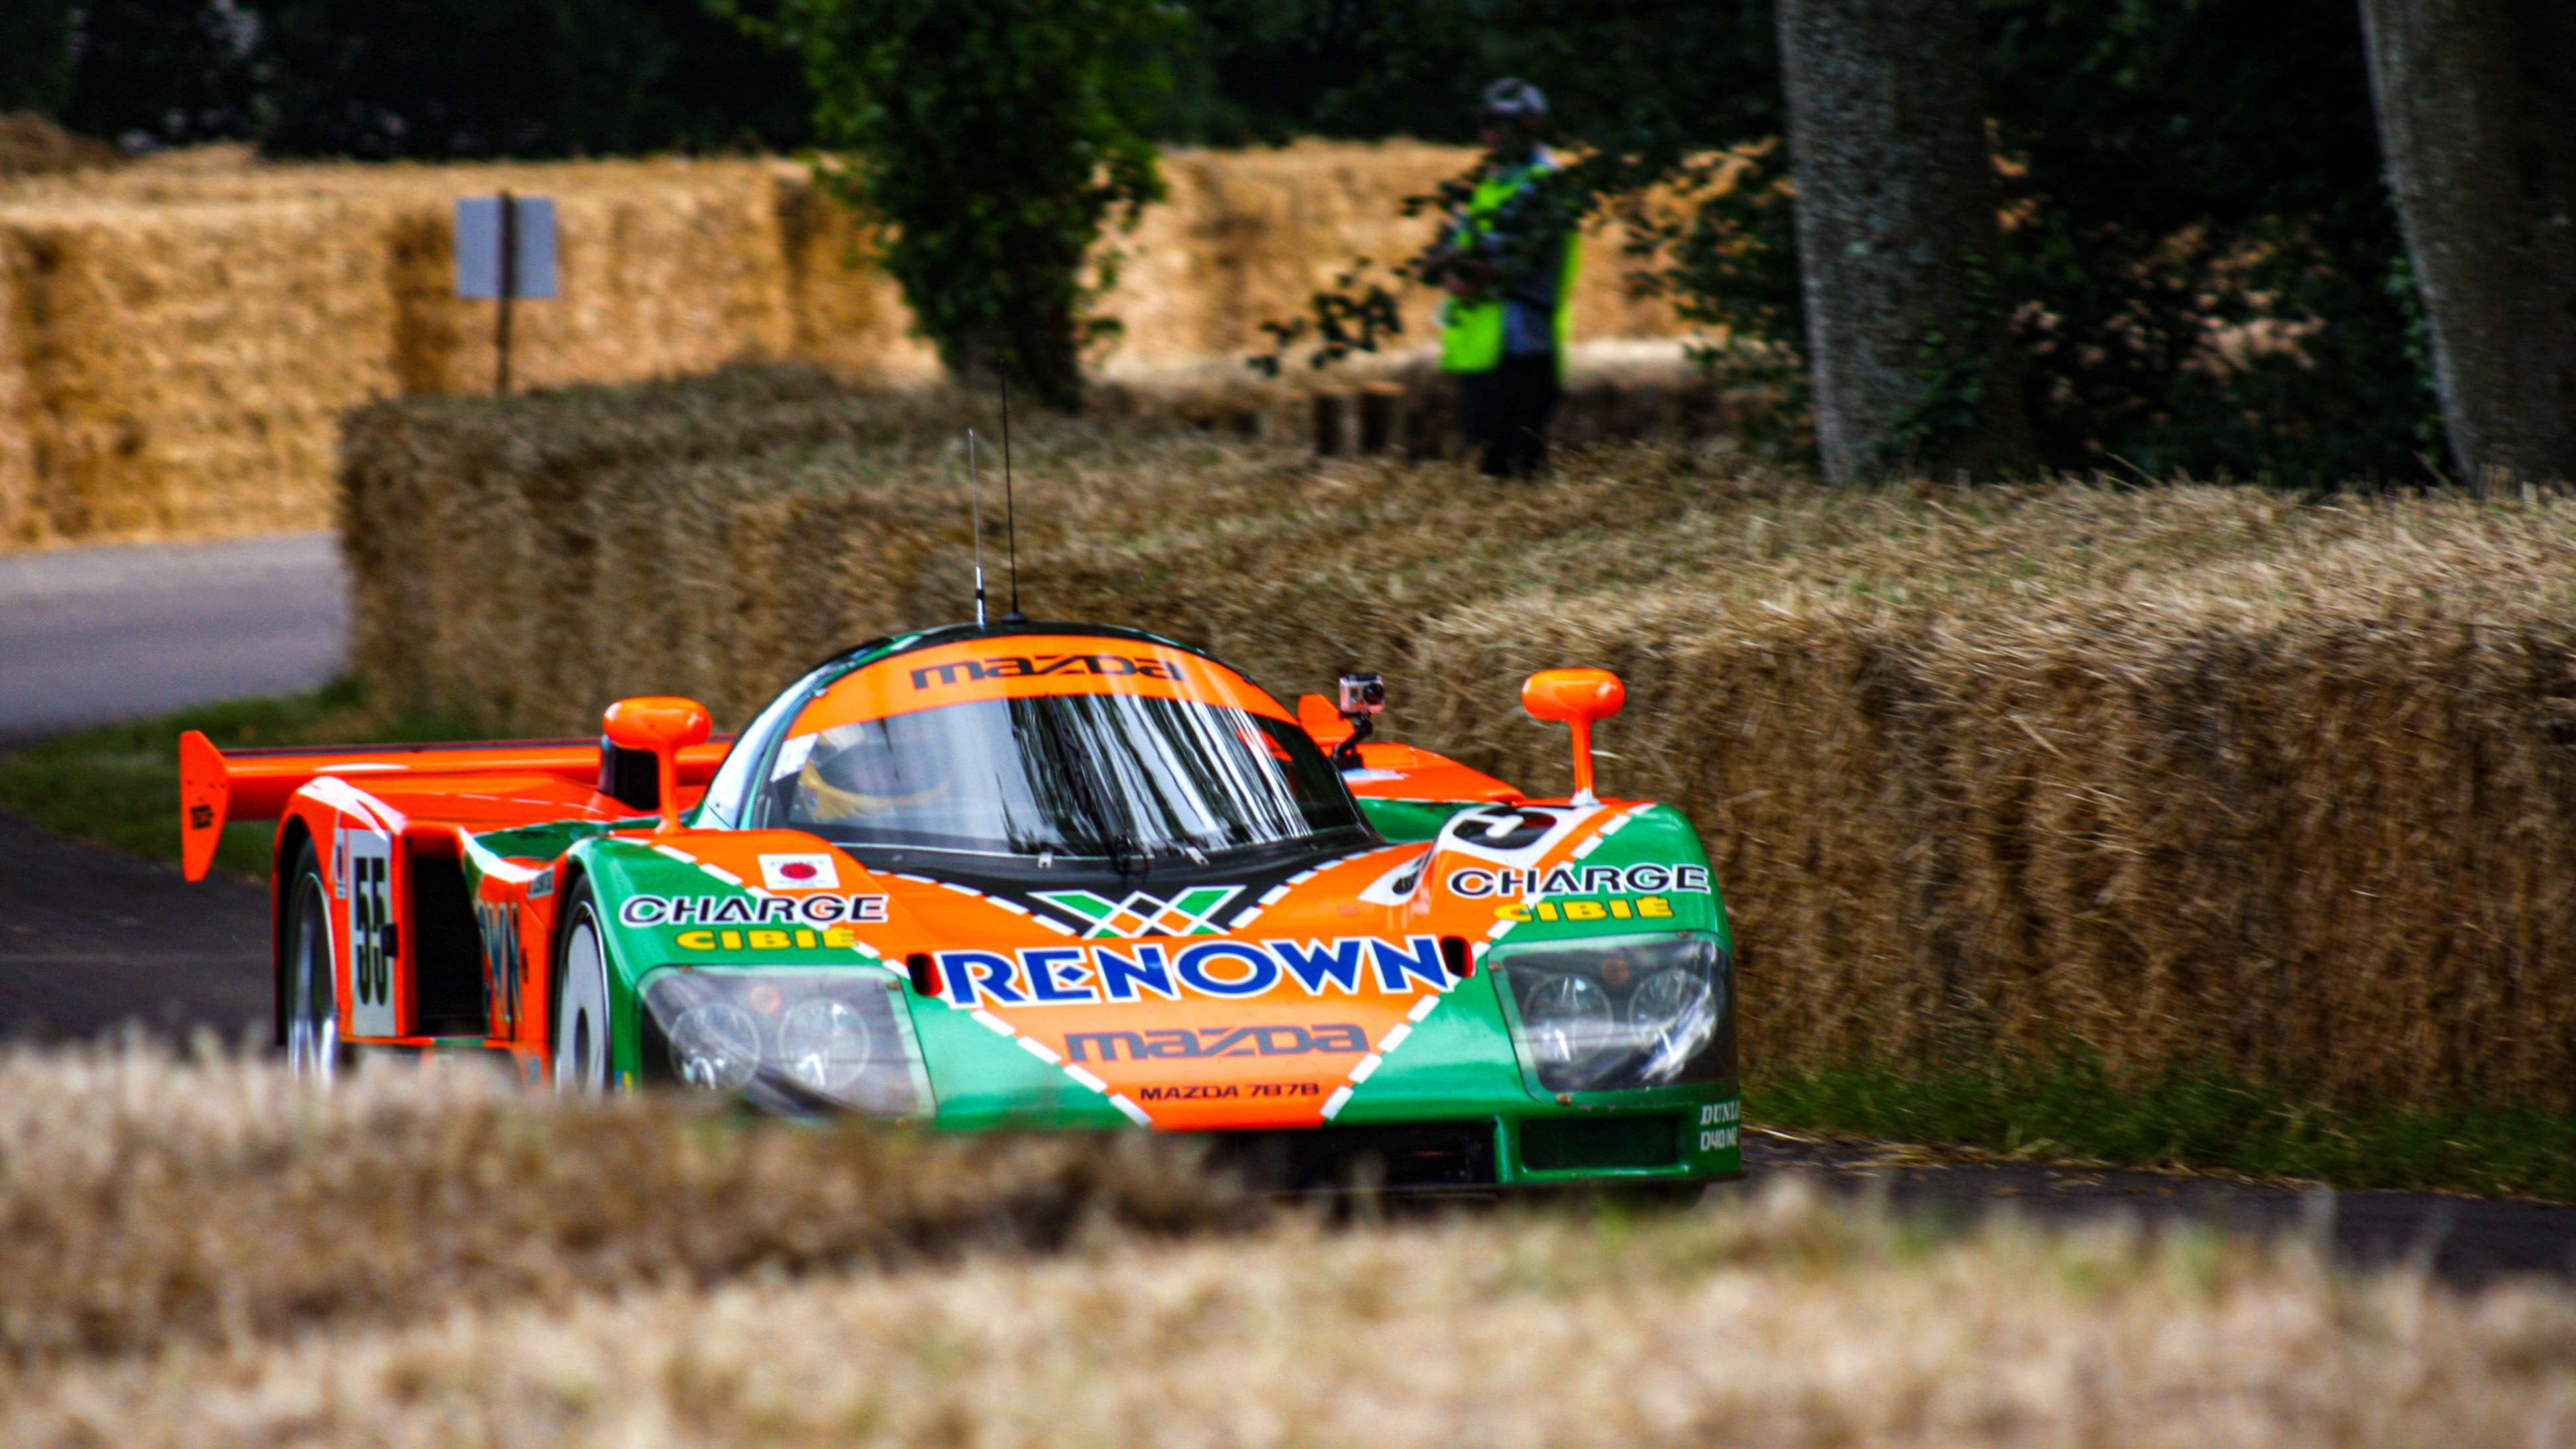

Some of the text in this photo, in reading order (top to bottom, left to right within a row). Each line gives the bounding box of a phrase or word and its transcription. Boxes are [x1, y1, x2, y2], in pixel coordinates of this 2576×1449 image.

[910, 655, 1184, 690] mazda
[1447, 863, 1711, 898] CHARGE
[620, 893, 888, 927] CHARGE
[353, 856, 388, 1006] 55
[934, 936, 1454, 1008] RENOWN
[1064, 1024, 1370, 1061] mazda
[1140, 1083, 1320, 1100] MAZDA 787B
